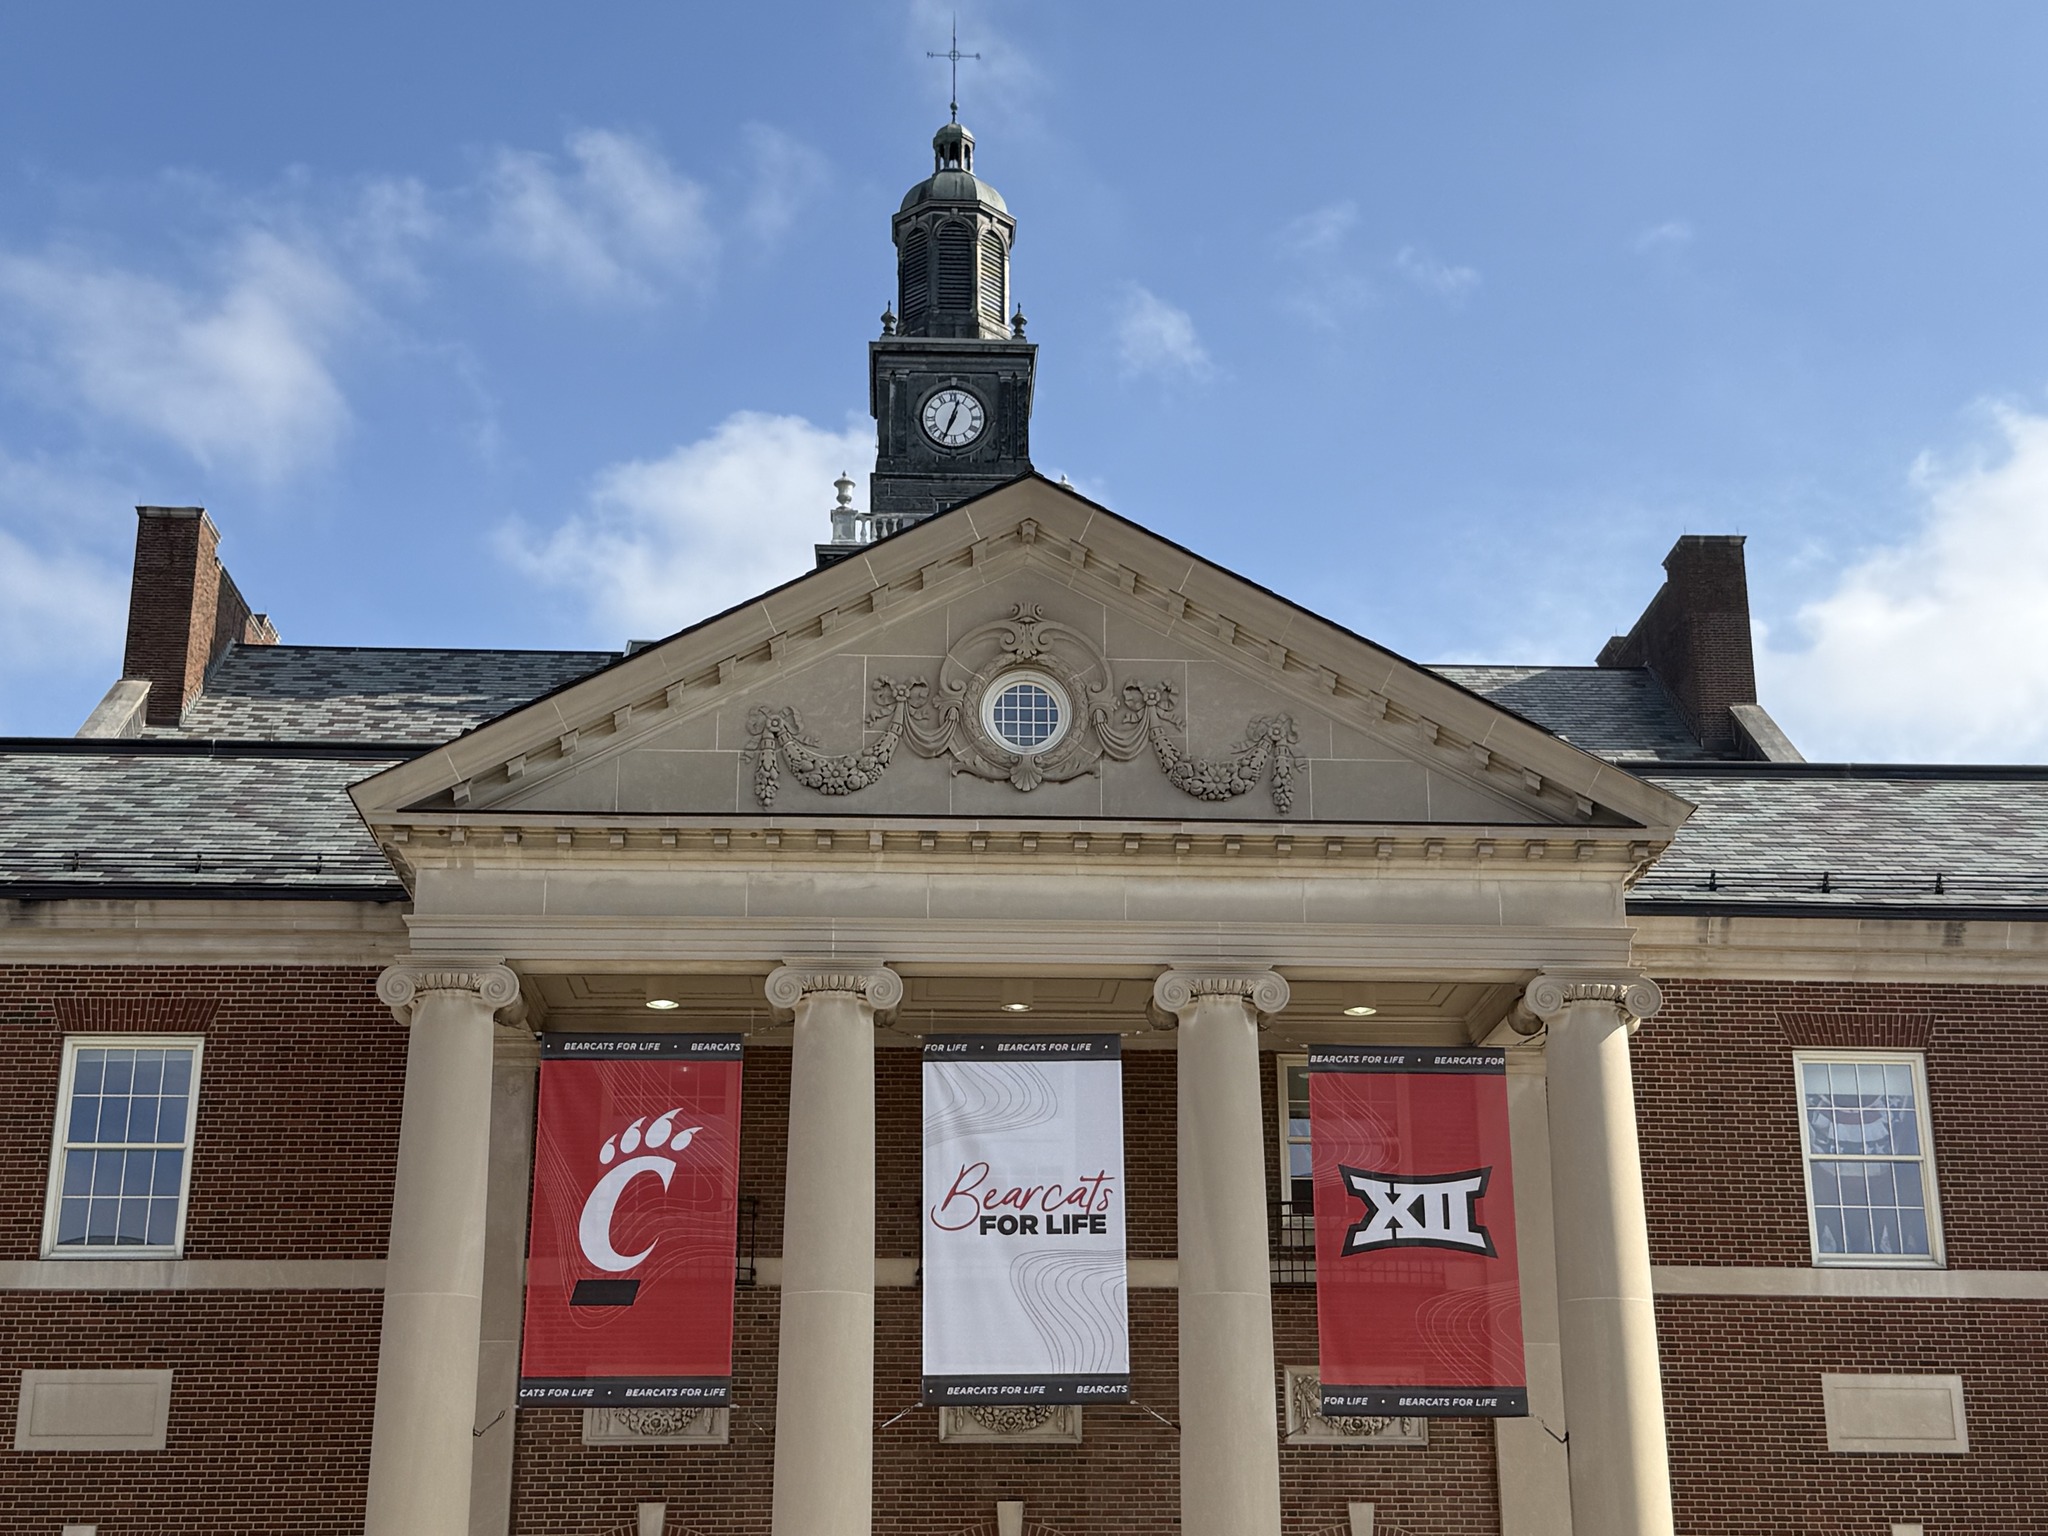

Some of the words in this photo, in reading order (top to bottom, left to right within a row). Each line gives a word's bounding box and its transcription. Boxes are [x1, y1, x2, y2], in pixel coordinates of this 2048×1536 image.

[564, 1042, 614, 1051] BEARCATS
[616, 1042, 637, 1051] FOR
[639, 1042, 661, 1051] LIFE
[691, 1042, 741, 1051] BEARCATS
[924, 1043, 945, 1052] FOR
[946, 1044, 968, 1052] LIFE
[997, 1043, 1047, 1052] BEARCATS
[1048, 1043, 1069, 1051] FOR
[1071, 1043, 1092, 1051] LIFE
[1310, 1055, 1359, 1064] BEARCATS
[1361, 1055, 1382, 1064] FOR
[1383, 1056, 1405, 1064] LIFE
[1434, 1056, 1483, 1065] BEARCATS
[1484, 1057, 1505, 1065] FOR
[930, 1161, 1115, 1231] Bearcats
[979, 1214, 1039, 1236] FOR
[1046, 1214, 1107, 1235] LIFE
[547, 1388, 569, 1397] FOR
[571, 1388, 594, 1397] LIFE
[625, 1388, 678, 1397] BEARCATS
[680, 1388, 702, 1397] FOR
[704, 1388, 726, 1397] LIFE
[947, 1386, 999, 1395] BEARCATS
[1000, 1386, 1022, 1395] FOR
[1023, 1386, 1046, 1394] LIFE
[1076, 1385, 1128, 1394] BEARCATS
[1323, 1396, 1344, 1406] FOR
[1346, 1397, 1368, 1406] LIFE
[1398, 1398, 1450, 1407] BEARCATS
[1452, 1398, 1473, 1407] FOR
[1475, 1398, 1497, 1407] LIFE
